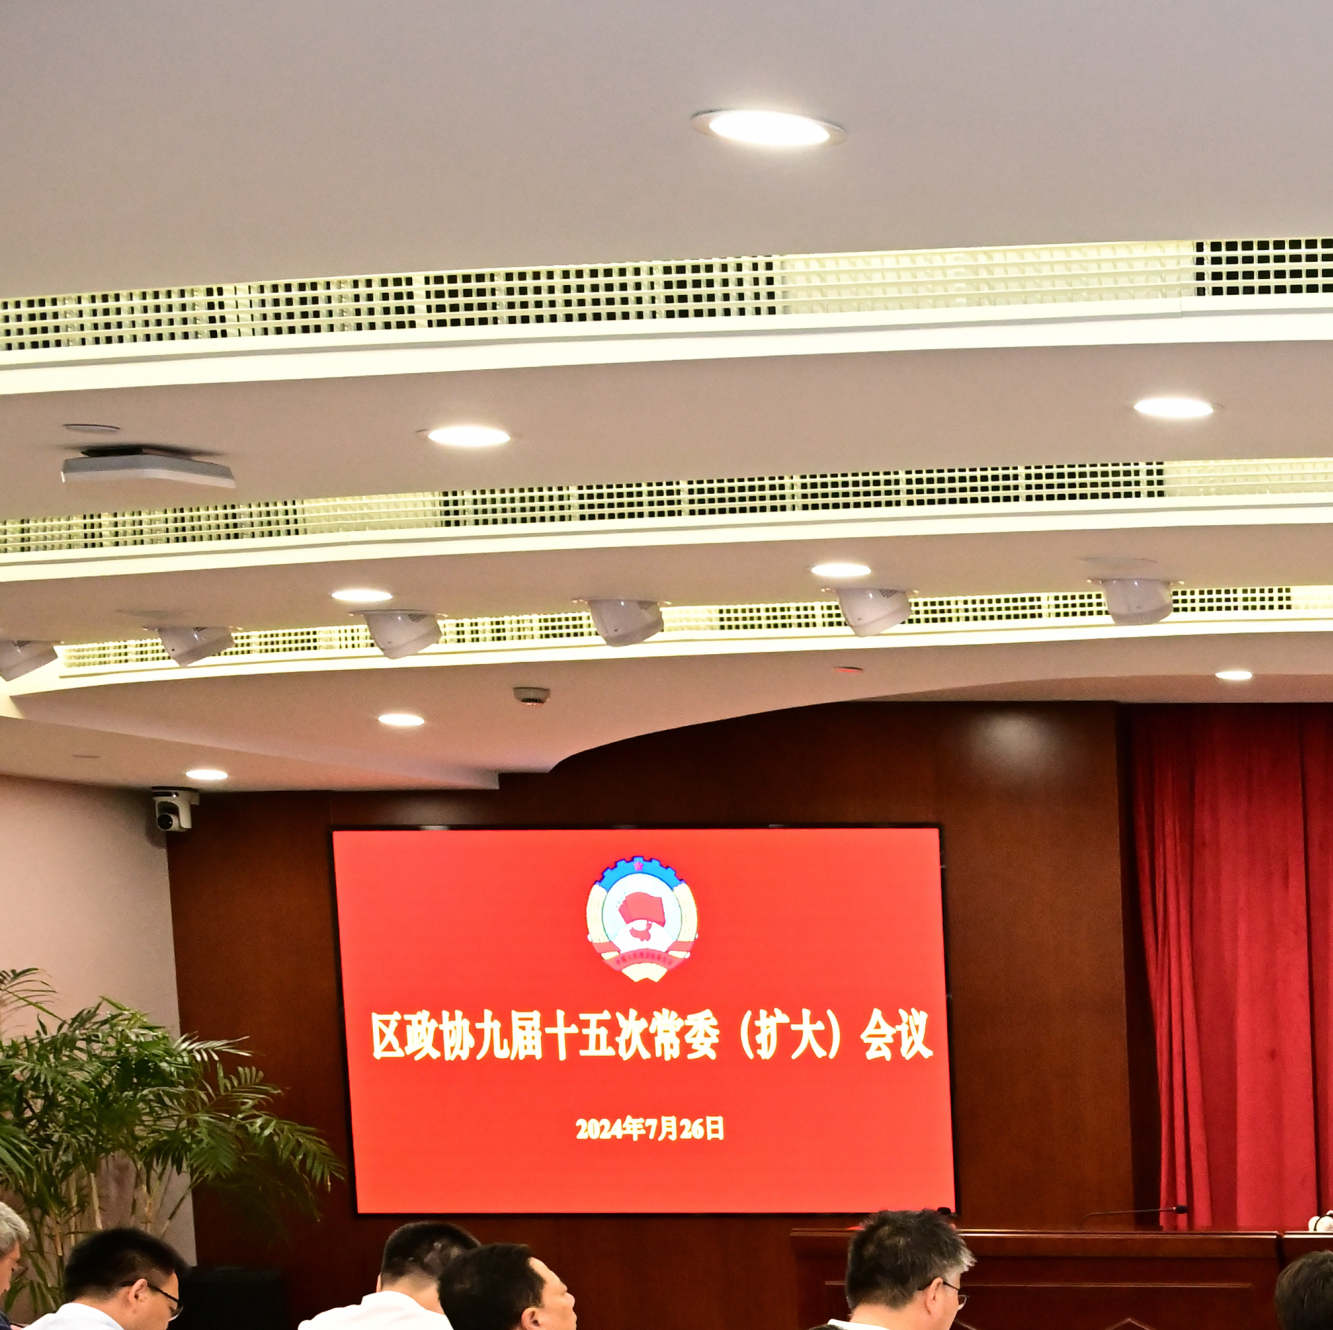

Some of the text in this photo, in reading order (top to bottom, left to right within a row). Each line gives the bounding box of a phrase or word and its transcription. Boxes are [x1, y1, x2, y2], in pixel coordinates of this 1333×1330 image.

[370, 1009, 934, 1061] 区政协九届十五次常委（扩大）会议
[575, 1115, 725, 1142] 2024年7月26日
